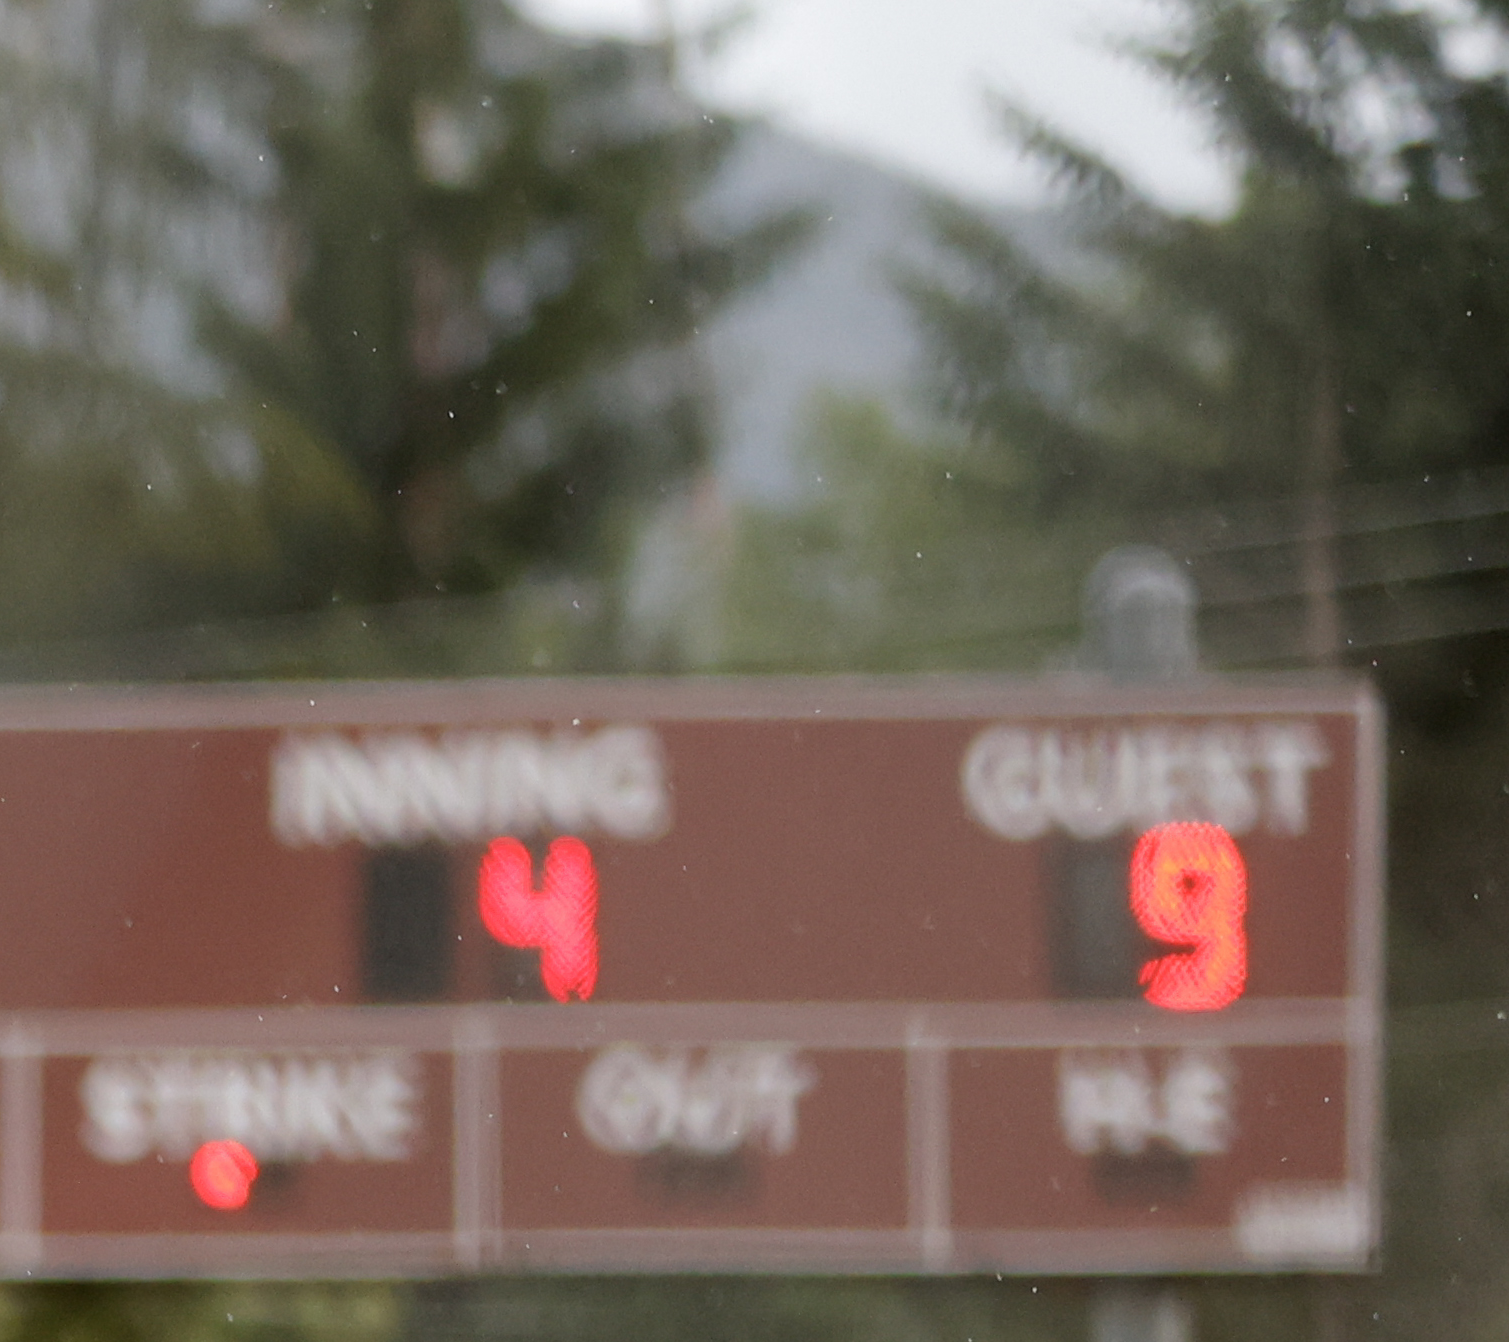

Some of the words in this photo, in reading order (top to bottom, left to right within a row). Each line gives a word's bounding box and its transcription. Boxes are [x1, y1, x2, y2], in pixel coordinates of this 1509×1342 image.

[272, 732, 668, 846] INNING
[964, 726, 1326, 841] GUEST
[480, 837, 598, 1002] 4
[1130, 821, 1247, 1012] 9
[82, 1060, 418, 1162] STRIKE
[577, 1045, 817, 1155] OUT
